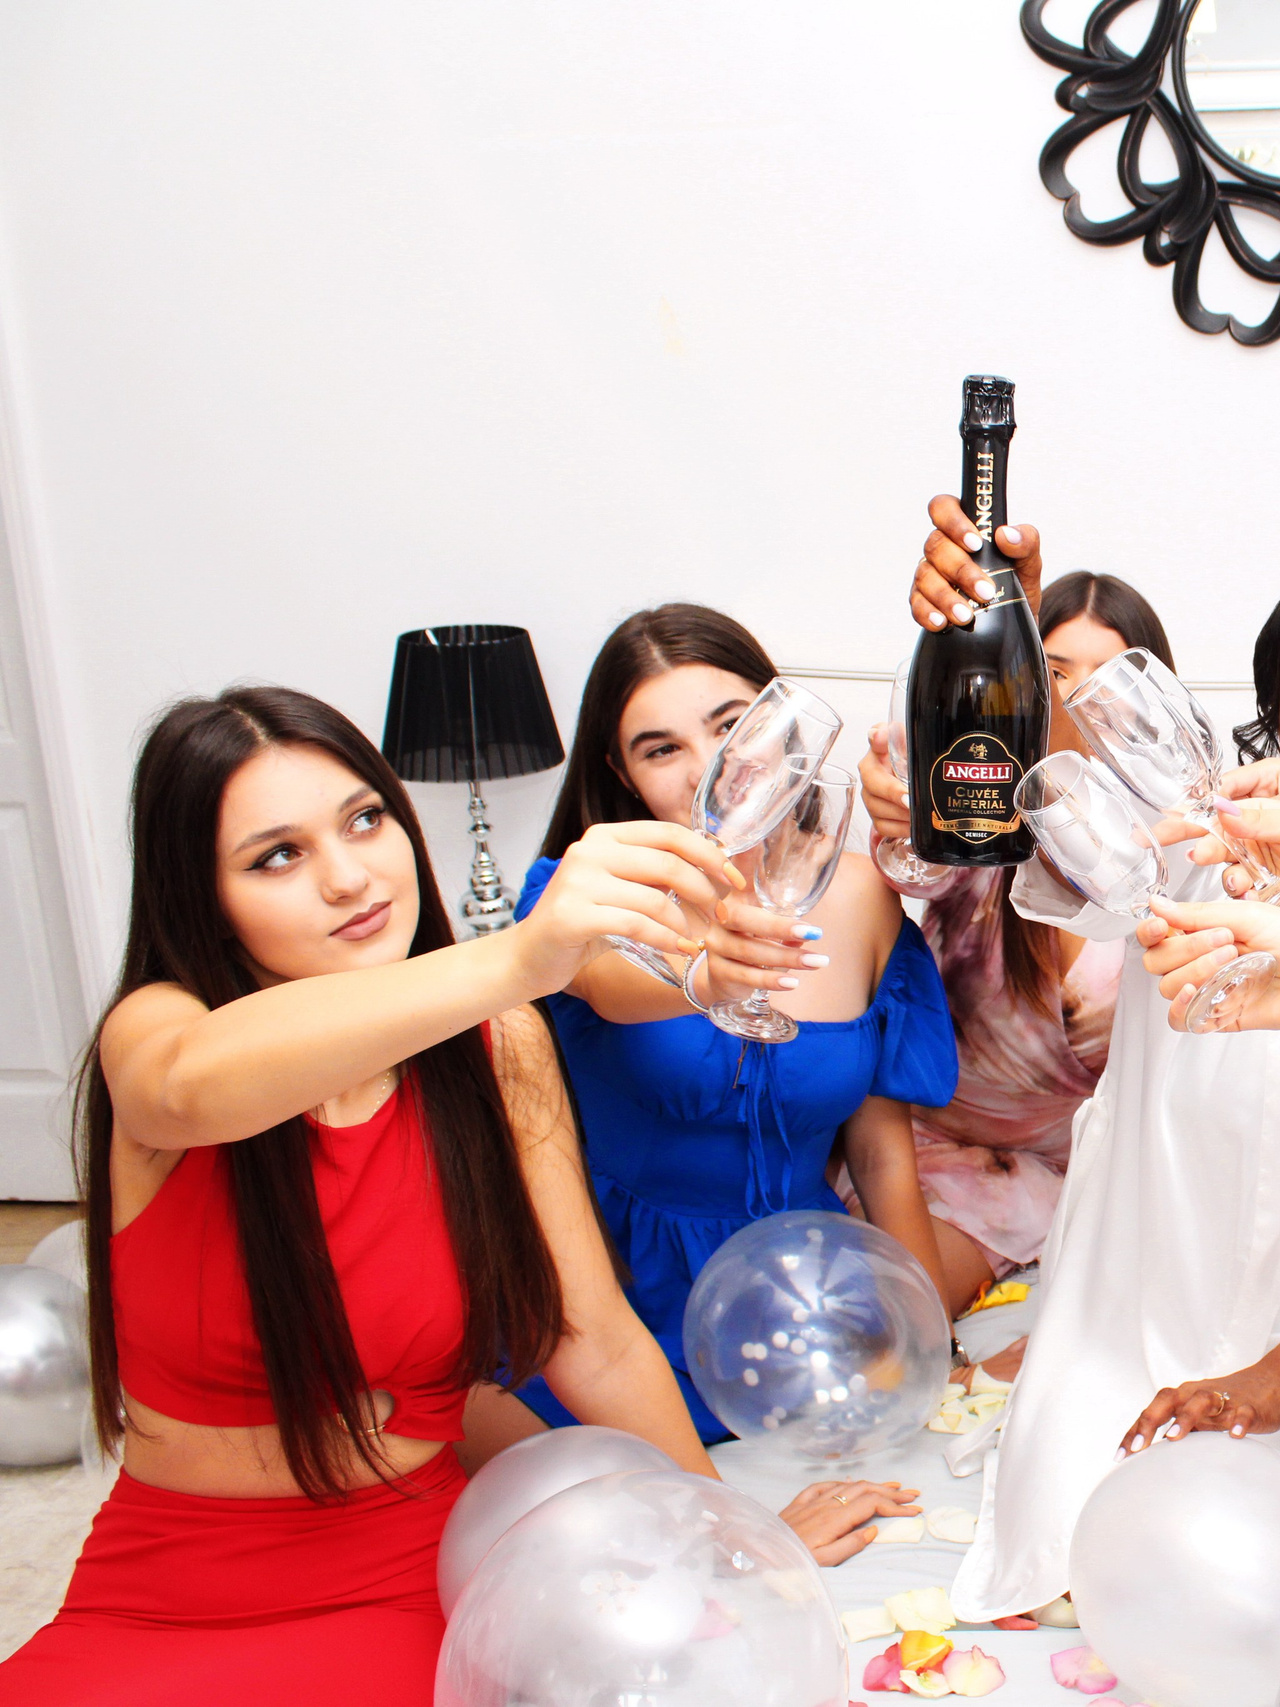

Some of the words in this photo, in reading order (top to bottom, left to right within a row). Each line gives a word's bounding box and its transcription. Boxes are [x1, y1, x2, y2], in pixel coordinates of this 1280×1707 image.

[976, 451, 994, 543] ANGELLI
[946, 765, 1010, 779] ANGELLI
[947, 796, 1006, 809] IMPERIAL
